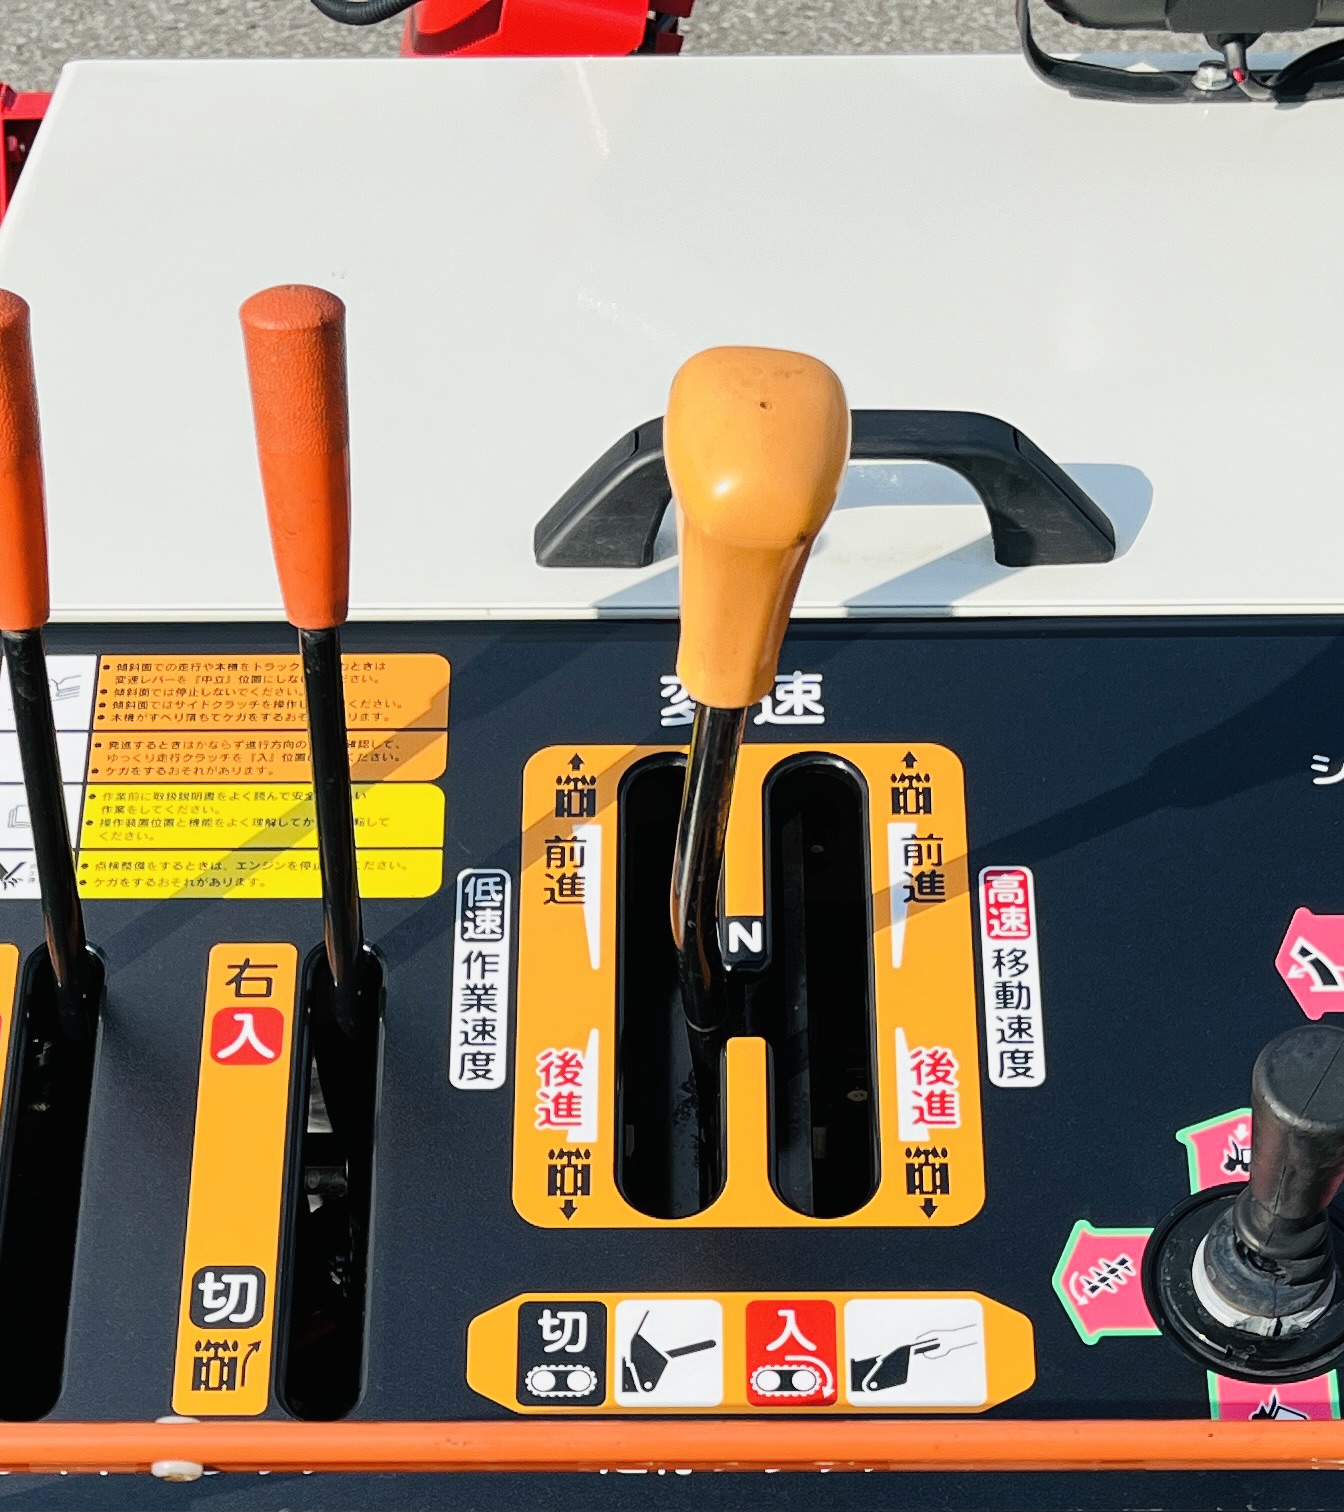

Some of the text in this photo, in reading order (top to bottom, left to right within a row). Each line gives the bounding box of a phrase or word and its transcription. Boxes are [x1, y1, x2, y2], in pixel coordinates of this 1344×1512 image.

[543, 835, 587, 905] 前進
[902, 834, 947, 904] 前進
[463, 874, 504, 940] 低速
[728, 921, 763, 953] N
[986, 873, 1030, 939] 高速
[224, 959, 279, 998] 右
[217, 1014, 275, 1059] 入
[459, 950, 501, 1083] 作業速度
[992, 947, 1036, 1081] 移動速度
[537, 1050, 584, 1127] 後進
[910, 1049, 959, 1126] 後進
[198, 1272, 257, 1322] 切
[538, 1310, 588, 1353] 切
[766, 1309, 816, 1352] 入
